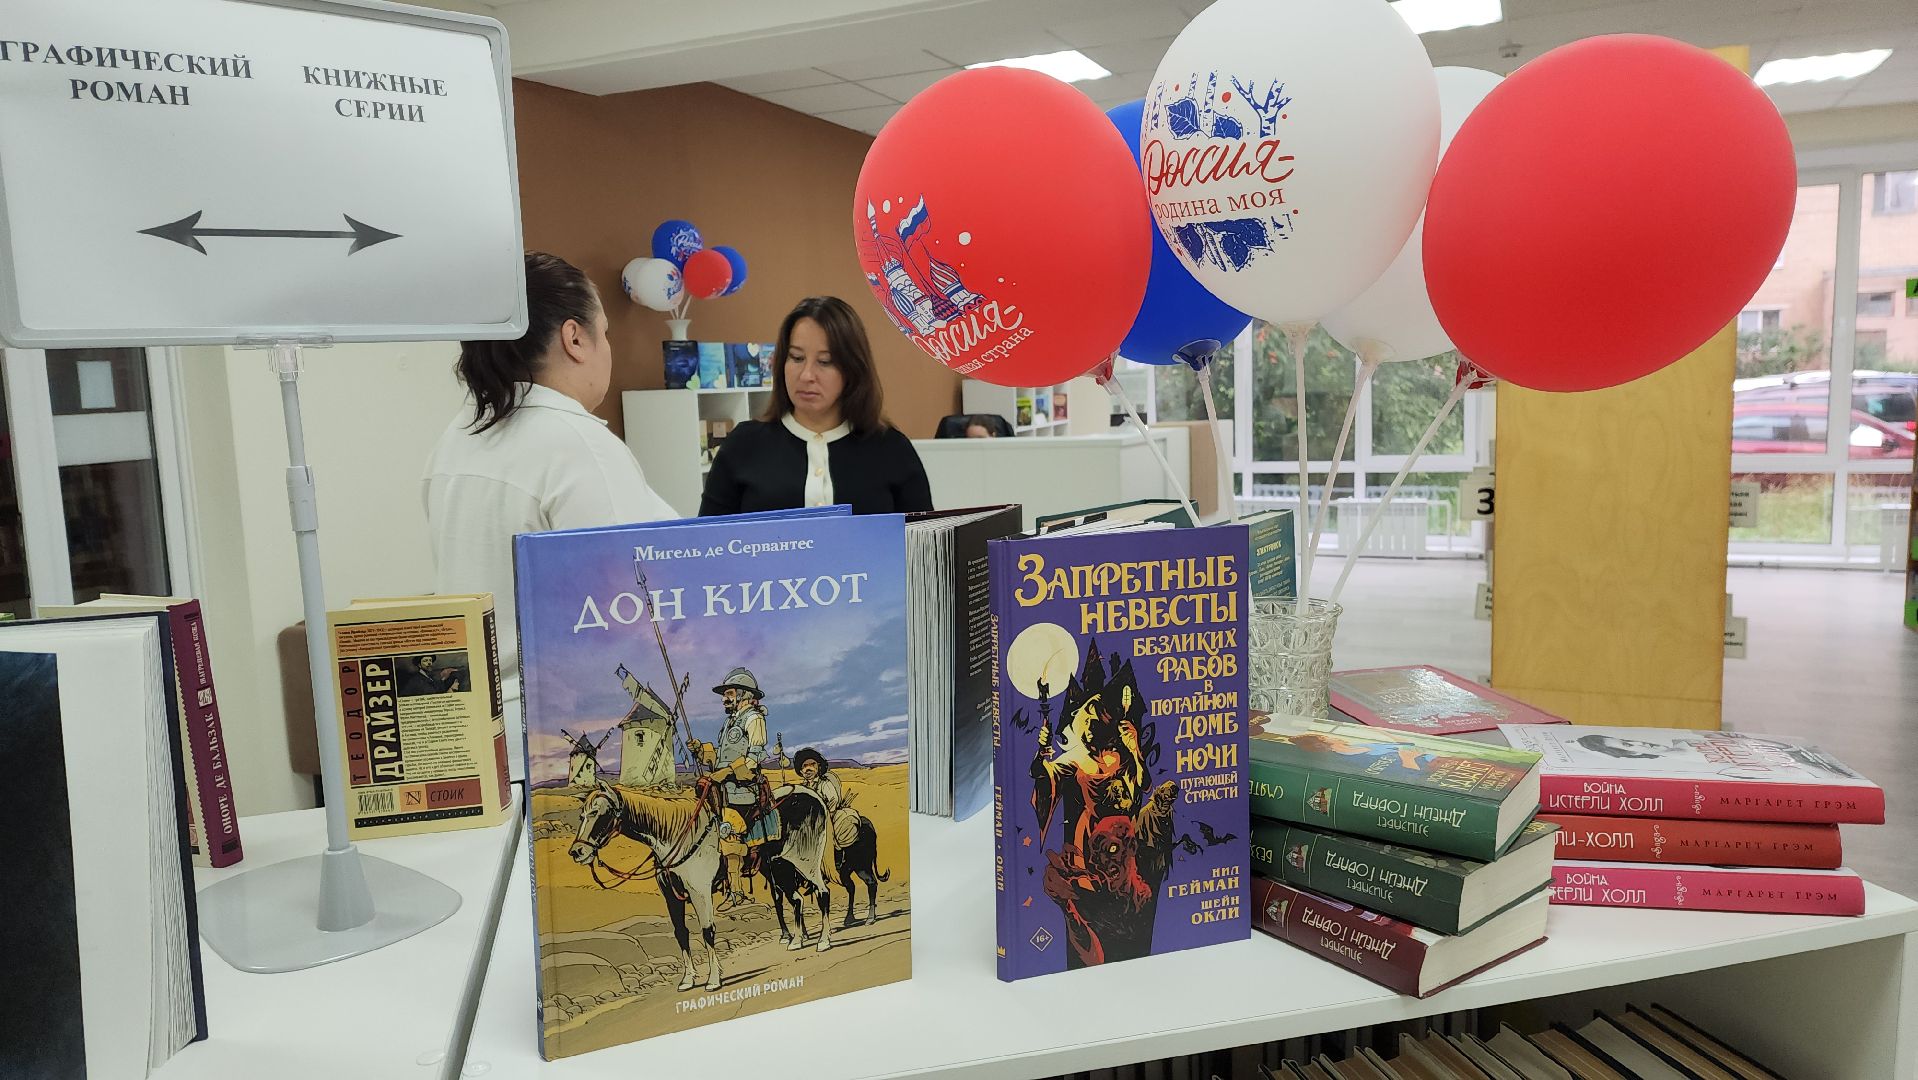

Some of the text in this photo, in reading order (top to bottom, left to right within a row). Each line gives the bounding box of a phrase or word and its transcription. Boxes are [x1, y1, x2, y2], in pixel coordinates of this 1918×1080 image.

[0, 40, 253, 80] ГРАФИЧЕСКИЙ
[69, 79, 190, 106] РОМАН
[303, 65, 448, 98] КНИЖНЫЕ
[334, 98, 425, 123] СЕРИИ
[1155, 188, 1286, 225] родина моя
[980, 327, 1034, 363] страна
[1477, 487, 1495, 515] 3
[634, 538, 814, 562] Мигель де Сервантес
[1015, 553, 1238, 608] ЗАПРЕТНЫЕ
[573, 572, 868, 634] ДОН КИХОТ
[1079, 591, 1238, 635] НЕВЕСТЫ
[1132, 628, 1237, 656] БЕЗЛИКИХ
[1156, 651, 1238, 683] РАБОВ
[1204, 680, 1213, 693] В
[1150, 692, 1238, 717] ПОТАЙНОМ
[342, 666, 366, 781] ТЕОДОР
[366, 663, 405, 780] ДРАЙЗЕР
[1174, 711, 1238, 744] ДОМЕ
[1176, 743, 1238, 774] НОЧИ
[204, 712, 233, 834] ОНОРЕ ДЕ БАЛЬЗАК
[1180, 771, 1238, 792] ПУГАЮЩЕЙ
[430, 788, 465, 802] СТОИК
[1184, 786, 1238, 804] СТРАСТИ
[1250, 779, 1284, 799] СМЯТЕ
[1584, 782, 1626, 795] ВОЙНА
[1352, 790, 1467, 828] ДЖЕЙН ГОВАРД
[1550, 795, 1664, 812] ИСТЕРЛИ ХОЛЛ
[1720, 796, 1857, 810] МАРГАРЕТ ГРЭМ
[1377, 816, 1430, 838] ЭЛИЗАБЕТ
[1554, 830, 1634, 849] ЛИ-ХОЛЛ
[1680, 839, 1815, 852] МАРГАРЕТ ГРЭМ
[1212, 866, 1239, 878] НИЛ
[1325, 850, 1428, 897] ДЖЕЙН ГОВАРД
[1566, 872, 1608, 886] ВОЙНА
[1168, 876, 1239, 898] ГЕЙМАН
[1346, 877, 1394, 903] ЭЛИЗАБЕТ
[1550, 886, 1646, 904] ТЕРЛИ ХОЛЛ
[1702, 888, 1838, 902] МАРГАРЕТ ГРЭМ
[1201, 895, 1239, 910] ШЕЙН
[1191, 907, 1239, 925] ОКЛИ
[1036, 935, 1050, 943] 16+
[1301, 906, 1397, 961] ДЖЕЙН ГОВАРД
[1320, 936, 1363, 965] ЭЛИЗАБЕТ
[675, 975, 804, 1014] ГРАФИЧЕСКИЙ РОМАН
